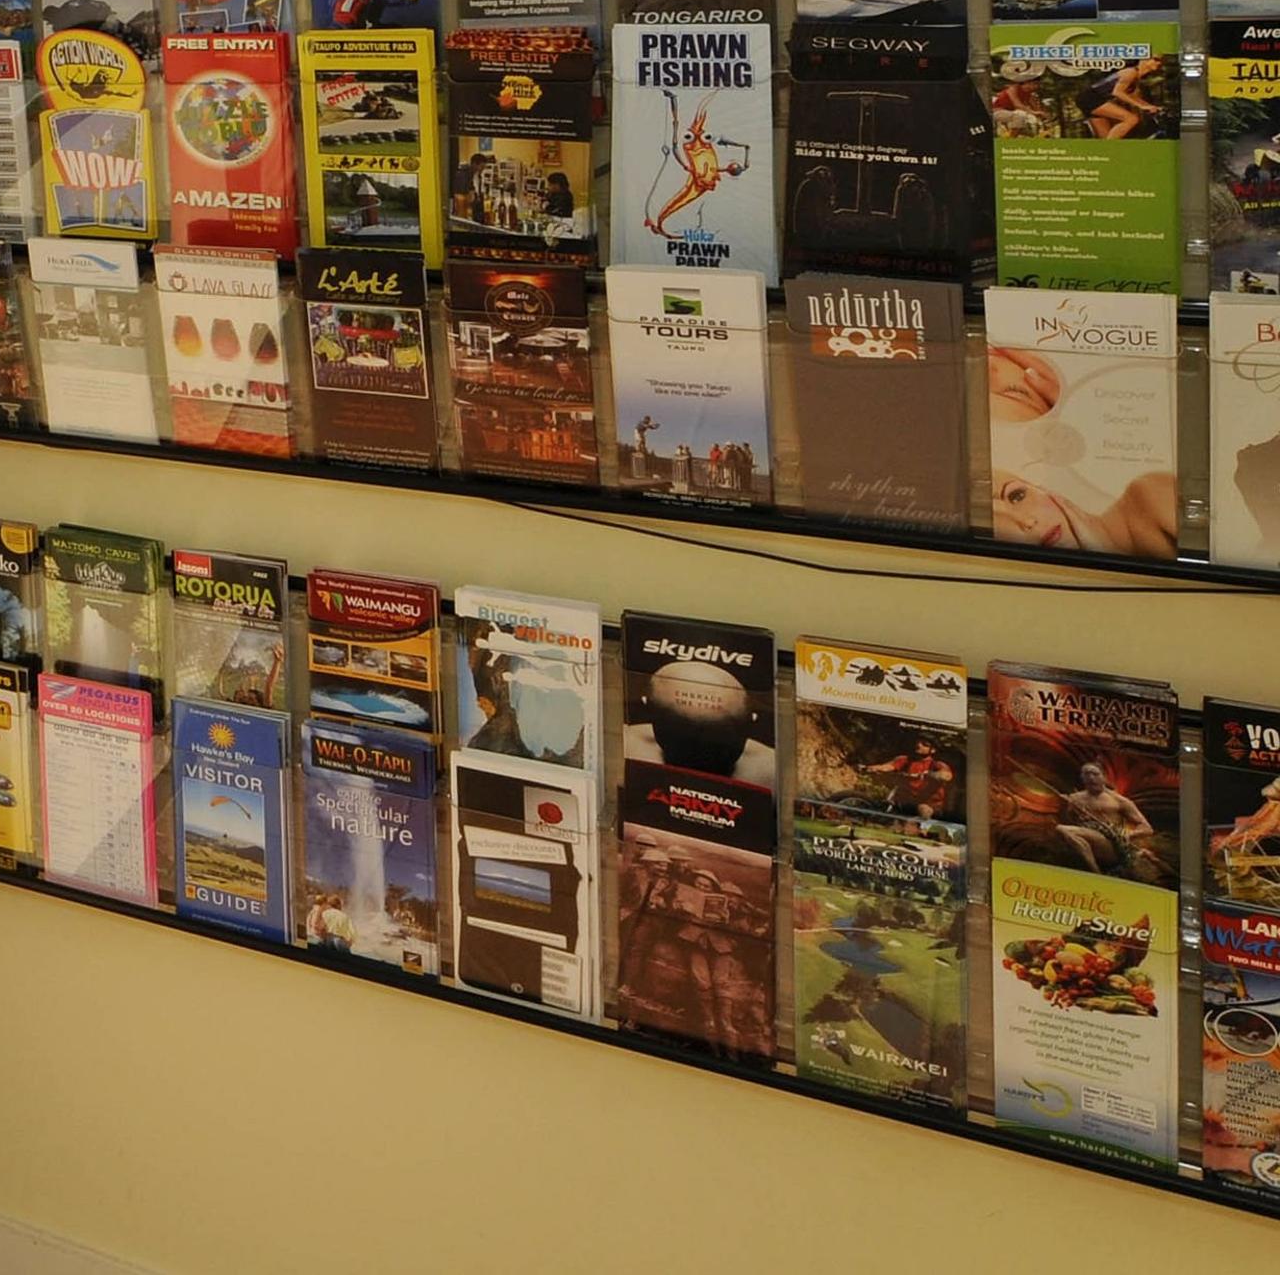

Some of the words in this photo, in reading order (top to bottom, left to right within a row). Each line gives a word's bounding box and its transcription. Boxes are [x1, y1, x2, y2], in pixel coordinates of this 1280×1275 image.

[632, 8, 764, 25] TONGARIRO
[167, 38, 209, 51] FREE
[213, 38, 275, 51] ENTRY!
[641, 32, 748, 60] PRAWN
[811, 36, 931, 52] SEGWAY
[1008, 44, 1075, 60] BIKE
[1080, 43, 1151, 58] HIRE
[639, 59, 753, 88] FISHING
[1071, 58, 1126, 72] taupo
[173, 189, 282, 211] AMAZEN
[667, 241, 730, 258] PRAWN
[640, 325, 729, 341] TOURS
[1035, 317, 1058, 331] IN
[1064, 328, 1159, 347] VOGUE
[176, 574, 276, 608] ROTORUA
[345, 594, 421, 619] WAIMANGU
[477, 606, 550, 629] Biggest
[642, 638, 753, 667] skydive
[820, 683, 878, 707] Mountain
[878, 694, 918, 712] Biking
[1039, 689, 1170, 724] WAIRAKEI
[1039, 706, 1170, 742] TERRACES
[315, 738, 412, 773] WAI-O-TAPU
[184, 762, 264, 792] VISITOR
[316, 791, 410, 824] Spectacular
[646, 789, 742, 821] ARMY
[668, 784, 742, 810] NATIONAL
[330, 812, 414, 847] nature
[668, 806, 736, 829] MUSEUM
[813, 835, 870, 856] PLAY
[882, 848, 952, 870] GOLF
[196, 886, 262, 915] GUIDE
[1001, 875, 1114, 917] Organic
[849, 1043, 949, 1079] WAIRAKEI
